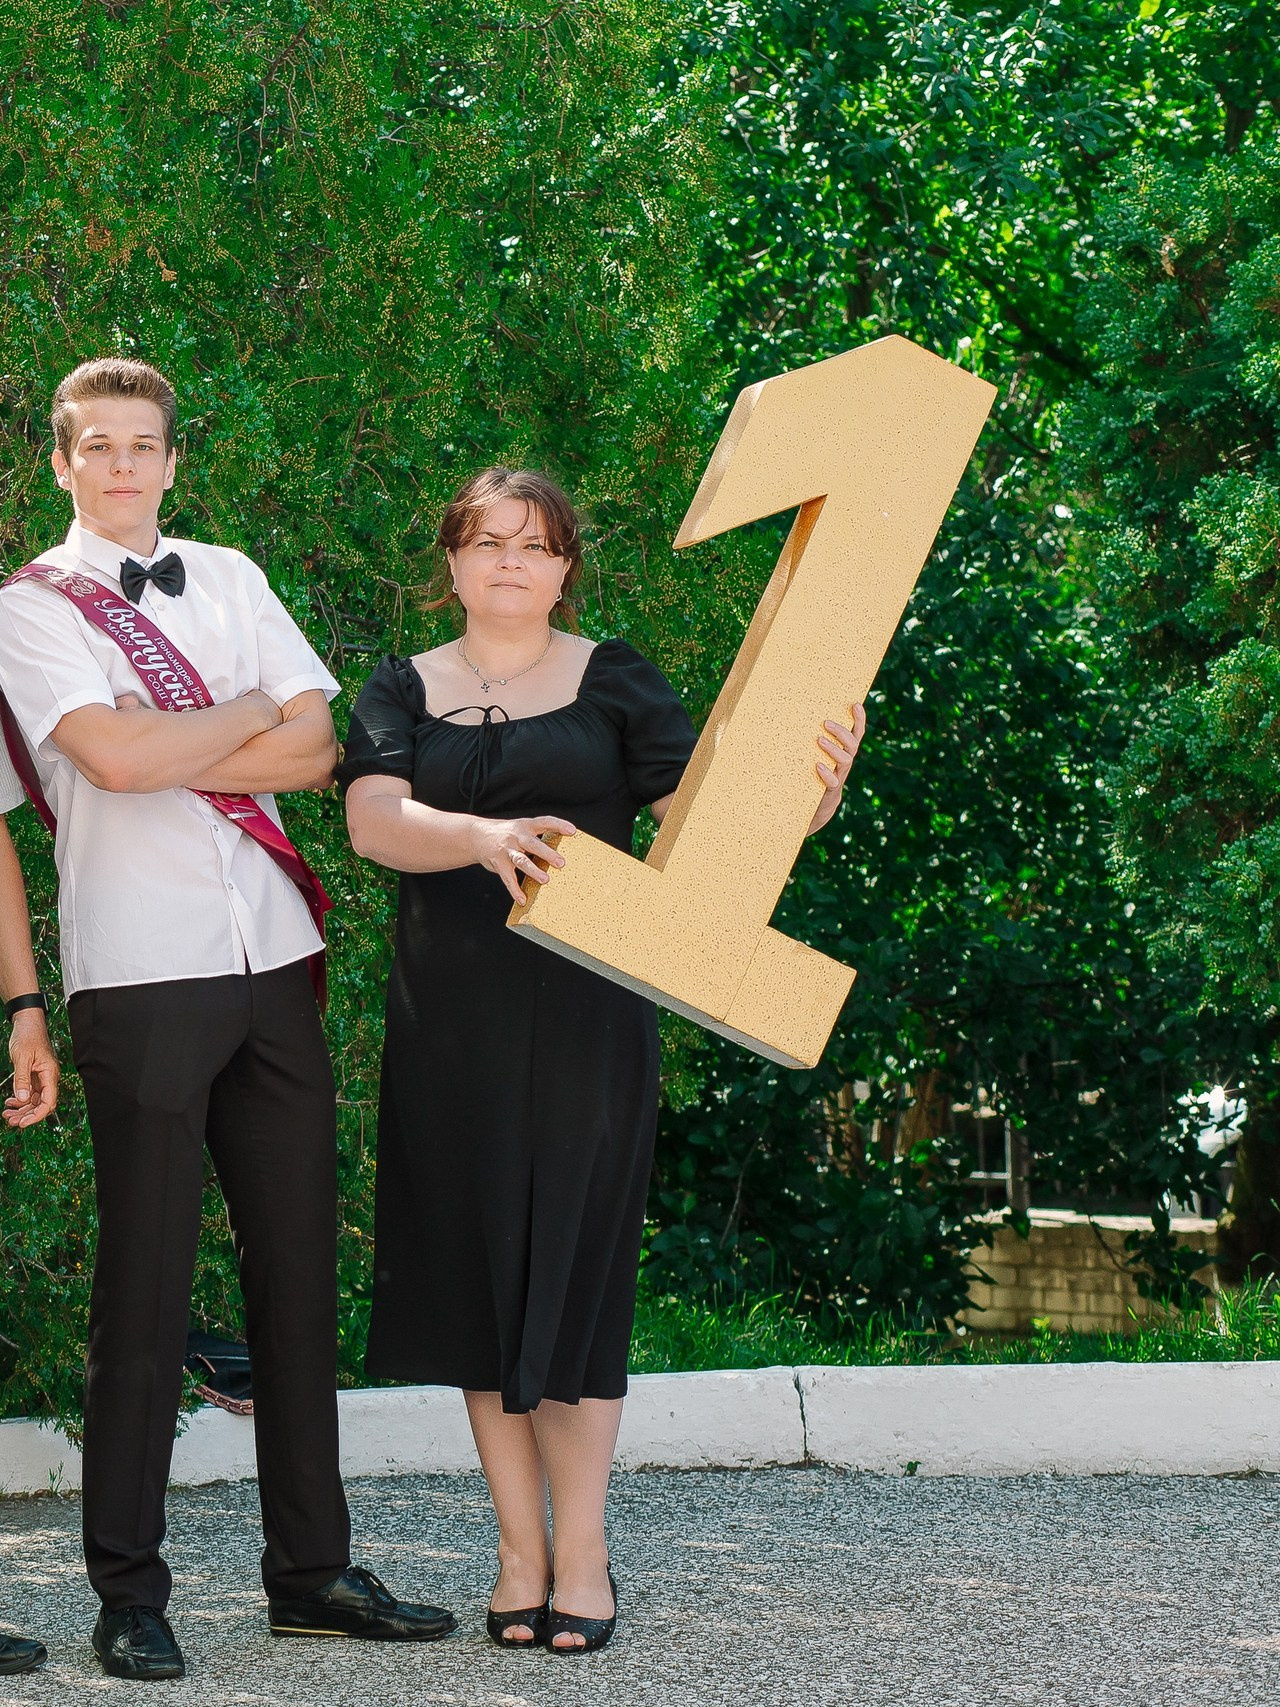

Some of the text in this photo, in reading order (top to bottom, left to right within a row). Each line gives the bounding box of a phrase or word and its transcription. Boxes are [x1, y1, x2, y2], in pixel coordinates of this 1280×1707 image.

[103, 622, 134, 646] МАОУ
[147, 673, 168, 700] СОШ
[154, 636, 194, 687] Пономарев
[506, 333, 998, 1069] 1
